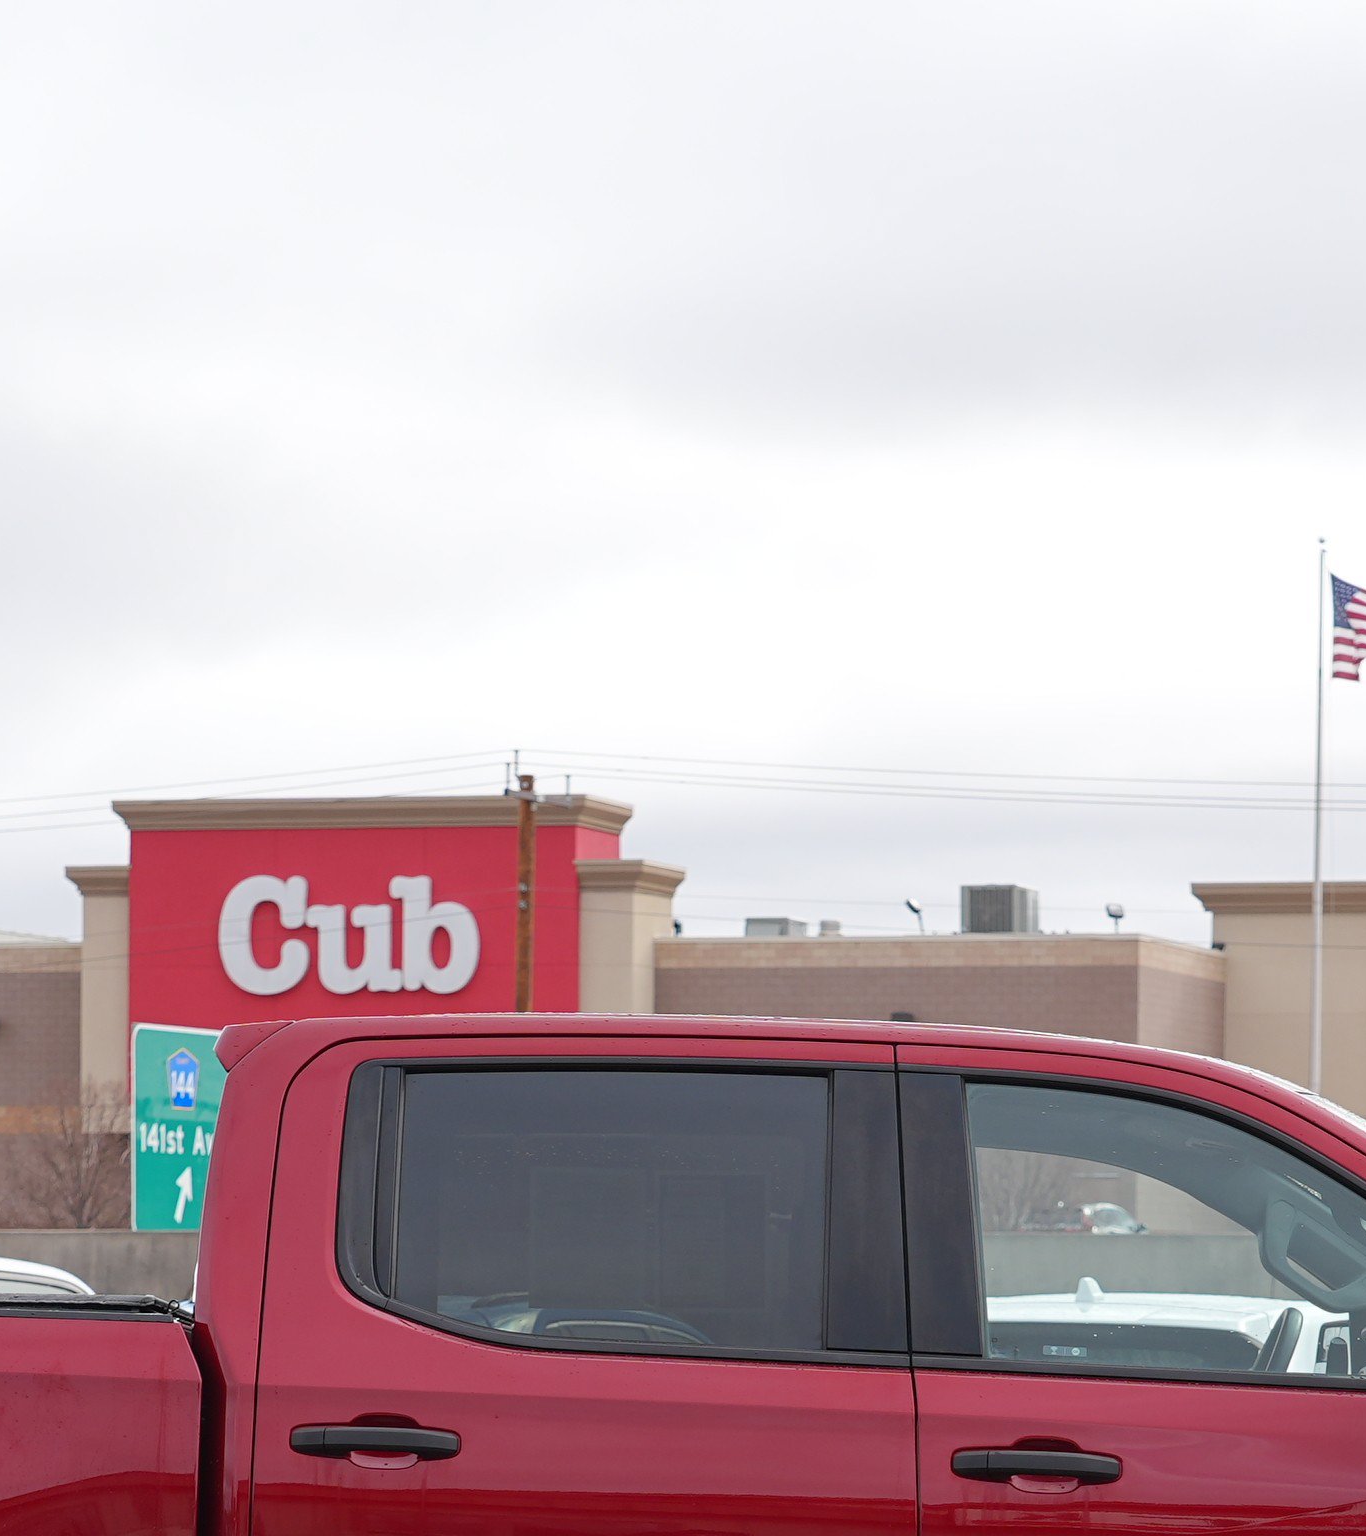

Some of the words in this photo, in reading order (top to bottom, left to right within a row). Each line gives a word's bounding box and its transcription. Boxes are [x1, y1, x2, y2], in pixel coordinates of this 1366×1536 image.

[218, 875, 481, 996] Cub
[171, 1070, 195, 1099] 144
[139, 1121, 185, 1155] 141st
